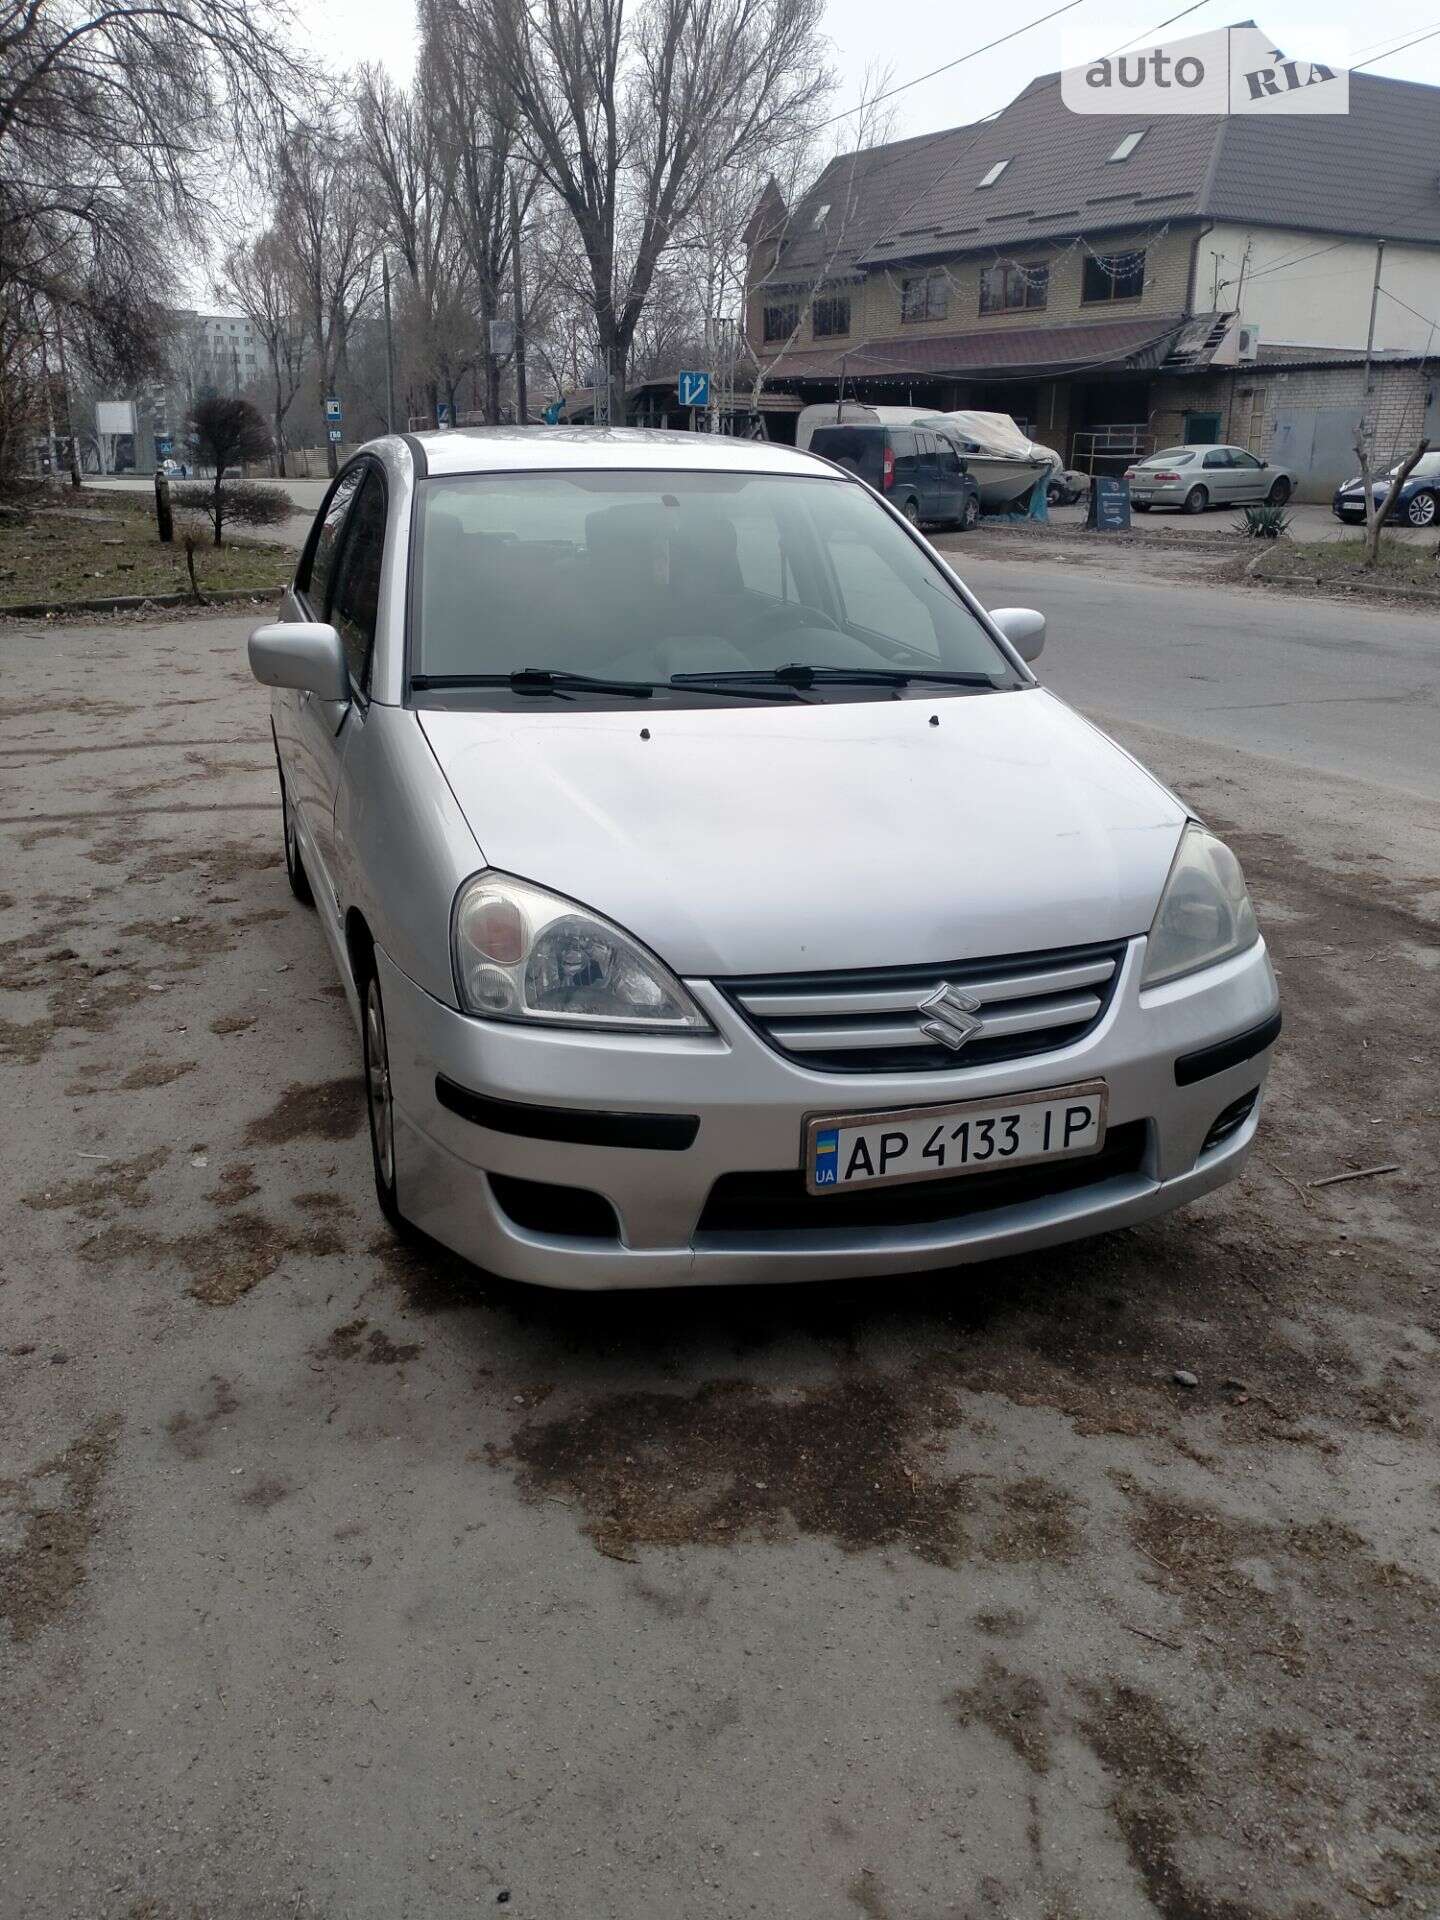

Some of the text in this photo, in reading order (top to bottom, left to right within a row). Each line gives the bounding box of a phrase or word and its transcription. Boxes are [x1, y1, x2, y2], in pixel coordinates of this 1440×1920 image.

[845, 1132, 908, 1179] AP
[922, 1115, 1020, 1166] 4133
[815, 1169, 834, 1183] UA
